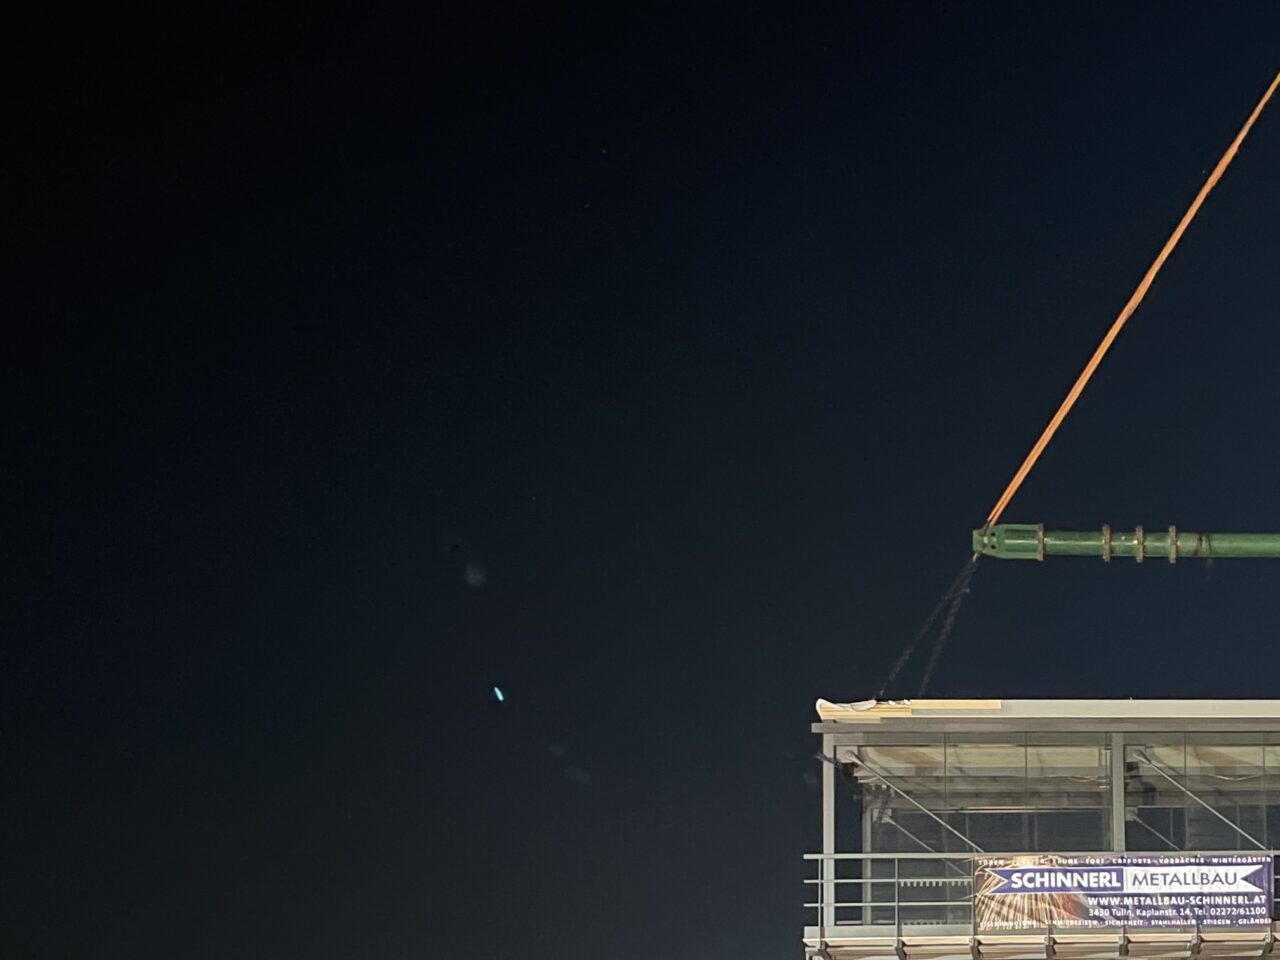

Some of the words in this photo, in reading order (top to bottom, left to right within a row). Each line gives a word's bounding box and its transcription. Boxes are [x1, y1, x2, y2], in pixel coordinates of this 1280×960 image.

[1113, 857, 1152, 865] CARPORTS
[1011, 872, 1121, 889] SCHINNERL
[1132, 872, 1237, 886] METALLBAU
[1088, 895, 1266, 906] WWW.METALLBAU-SCHINNERL.AT
[1088, 908, 1110, 917] 3430
[1210, 906, 1267, 916] 02272/61100
